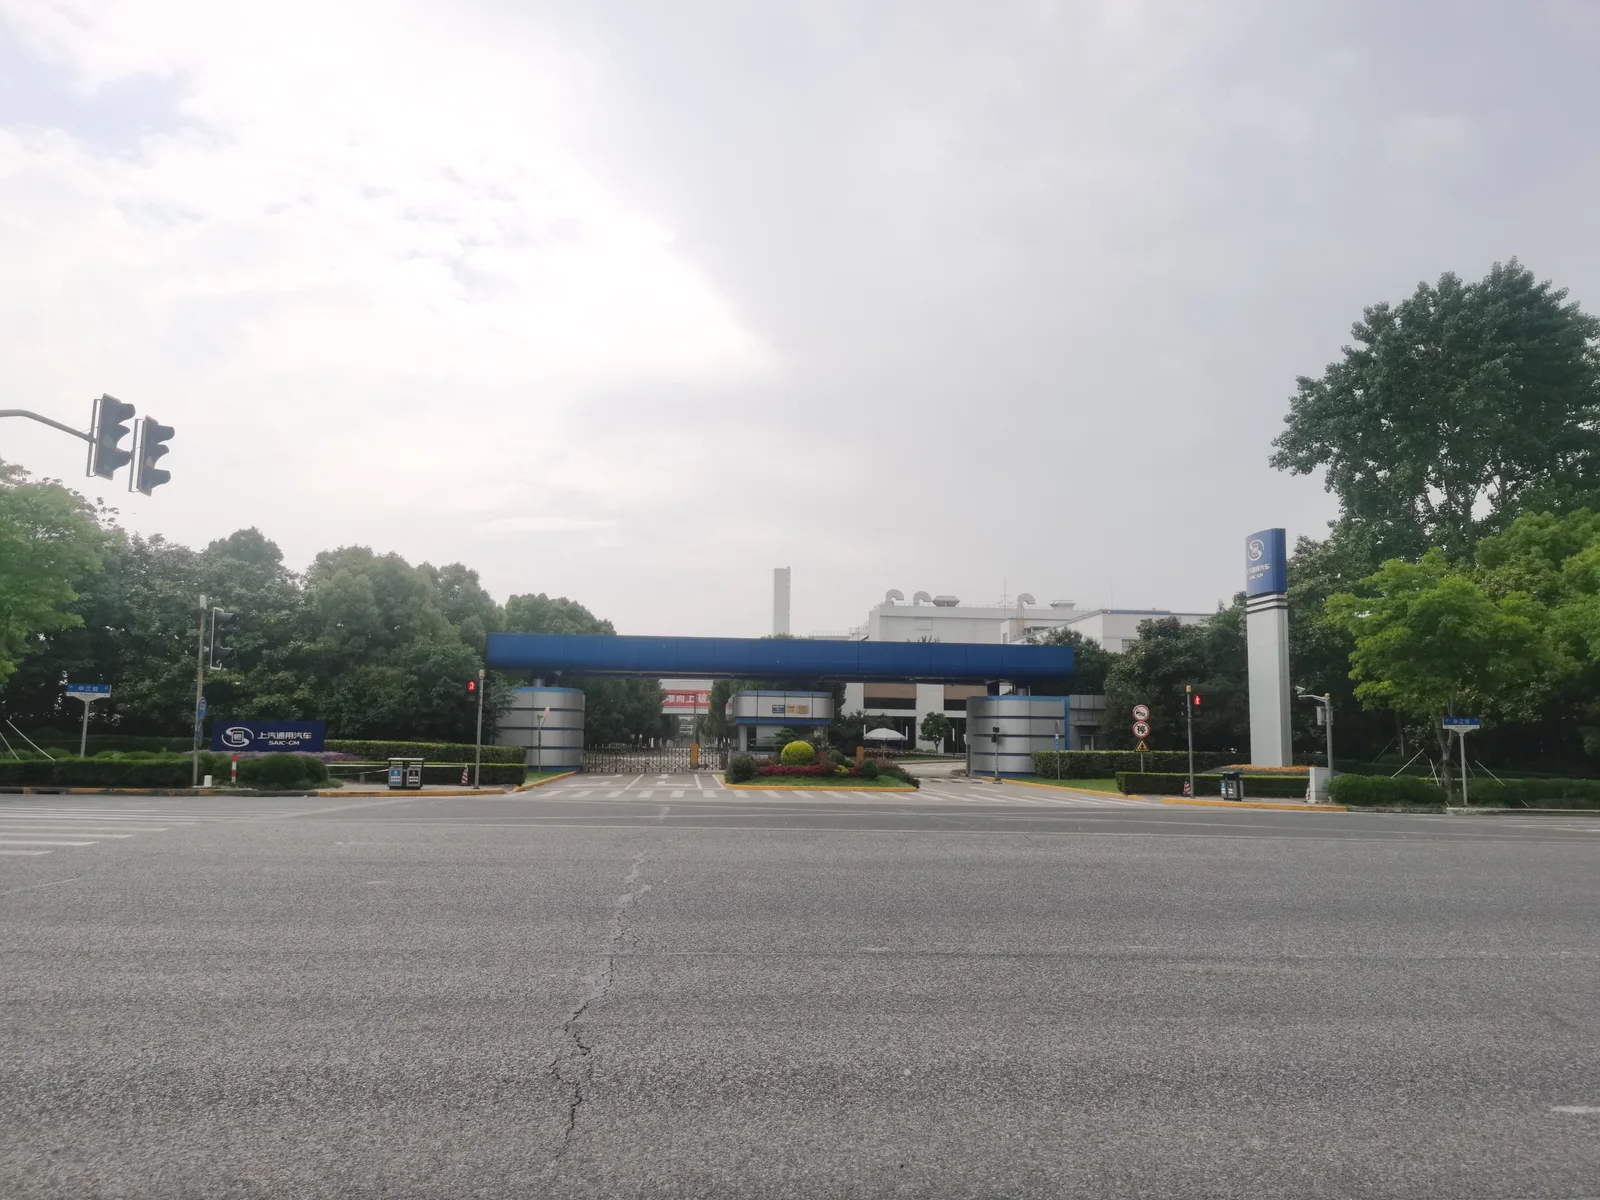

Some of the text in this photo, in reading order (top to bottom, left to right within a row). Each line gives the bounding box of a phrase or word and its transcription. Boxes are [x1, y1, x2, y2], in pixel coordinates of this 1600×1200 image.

[257, 731, 312, 740] 上汽通用汽车
